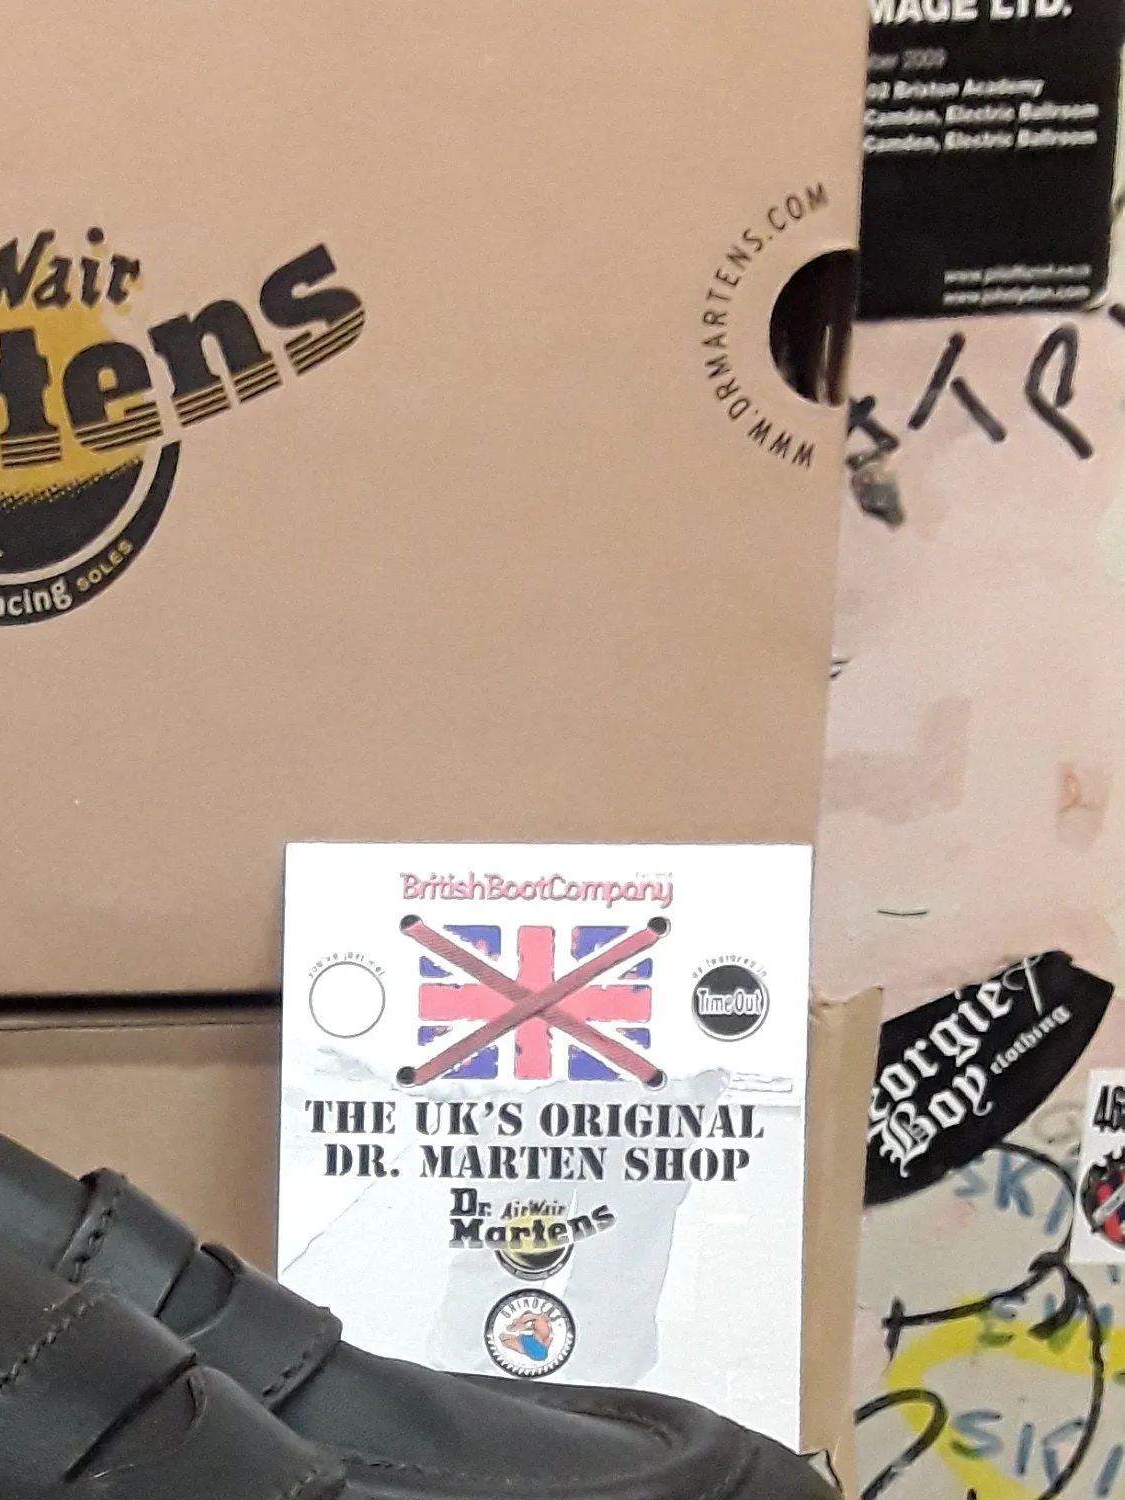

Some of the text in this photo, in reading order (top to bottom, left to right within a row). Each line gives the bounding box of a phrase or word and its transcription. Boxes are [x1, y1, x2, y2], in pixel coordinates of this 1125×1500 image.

[700, 182, 829, 470] WWW.DRMARTENS.COM
[77, 540, 133, 592] SOLES
[400, 871, 674, 908] BritishBootCompany
[990, 1004, 1073, 1076] clothing
[304, 1100, 765, 1140] THE UK'S ORIGINAL
[868, 1062, 994, 1179] Boy
[324, 1143, 751, 1183] DR. MARTEN SHOP
[450, 1187, 493, 1217] Dr.
[448, 1203, 617, 1249] Martens
